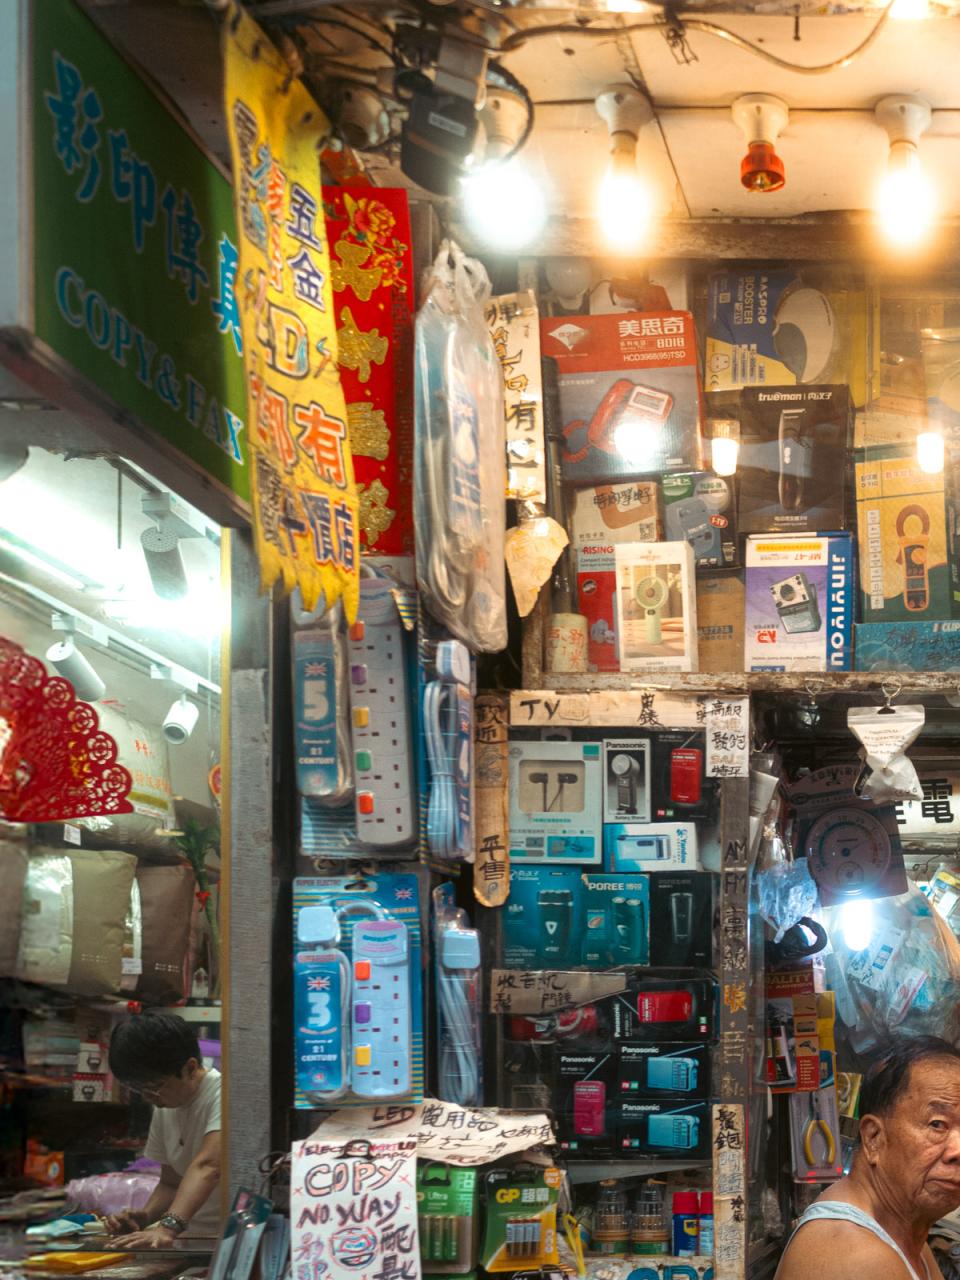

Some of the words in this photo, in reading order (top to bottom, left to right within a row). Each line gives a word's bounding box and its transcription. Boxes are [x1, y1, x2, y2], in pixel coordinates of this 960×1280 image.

[283, 181, 327, 311] 五金
[618, 317, 685, 337] 美思奇
[303, 681, 329, 721] 5
[606, 741, 646, 749] Panasonic
[299, 756, 335, 765] CENTURY
[767, 974, 812, 986] ALITY
[307, 992, 332, 1027] 3
[613, 1003, 621, 1038] Panasonic
[301, 1054, 338, 1062] CENTURY
[621, 1046, 660, 1054] Panasonic
[622, 1103, 660, 1112] Panasonic
[370, 1106, 416, 1126] LED
[304, 1158, 407, 1198] COPY
[427, 1191, 449, 1201] Ultra
[496, 1188, 520, 1204] GP
